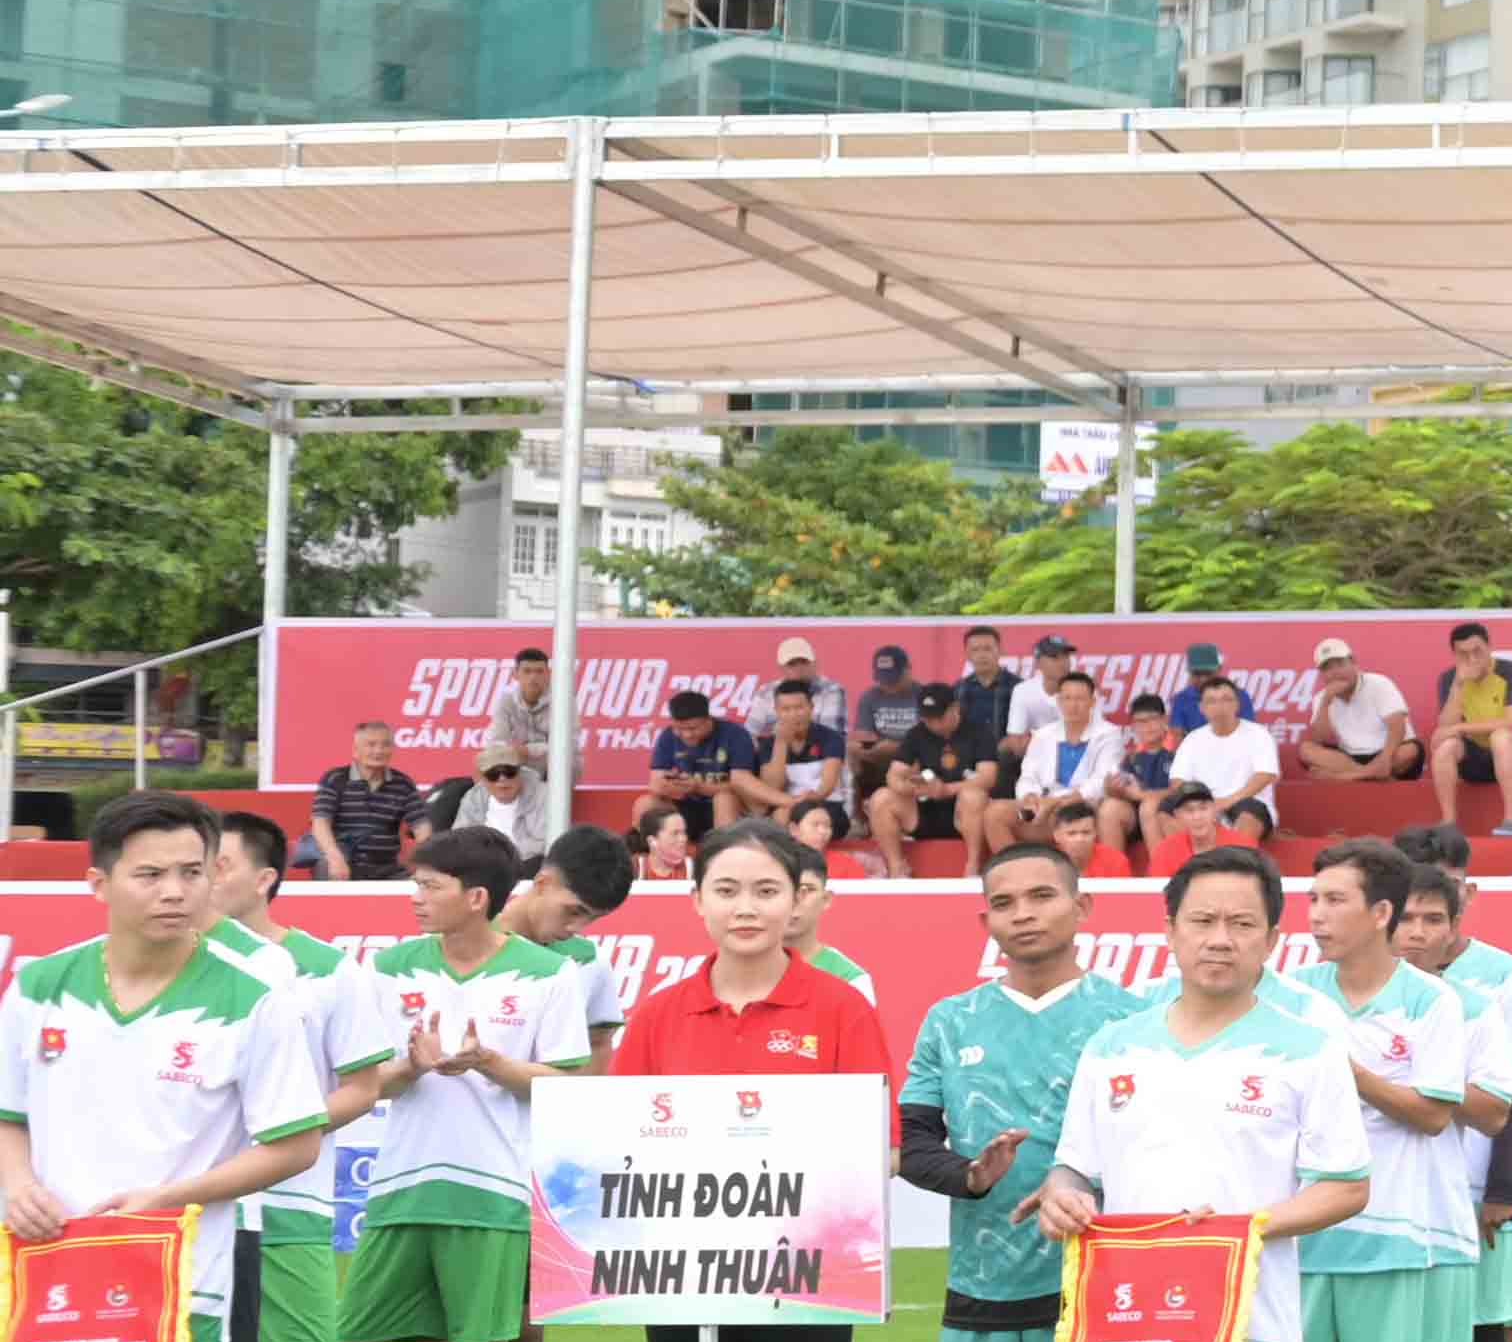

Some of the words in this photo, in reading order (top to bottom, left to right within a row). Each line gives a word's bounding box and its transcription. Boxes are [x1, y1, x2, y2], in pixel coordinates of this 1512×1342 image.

[600, 1155, 685, 1218] TỈNH
[693, 1159, 804, 1218] ĐOÀN
[590, 1249, 686, 1295] NINH
[697, 1235, 822, 1309] THUẬN
